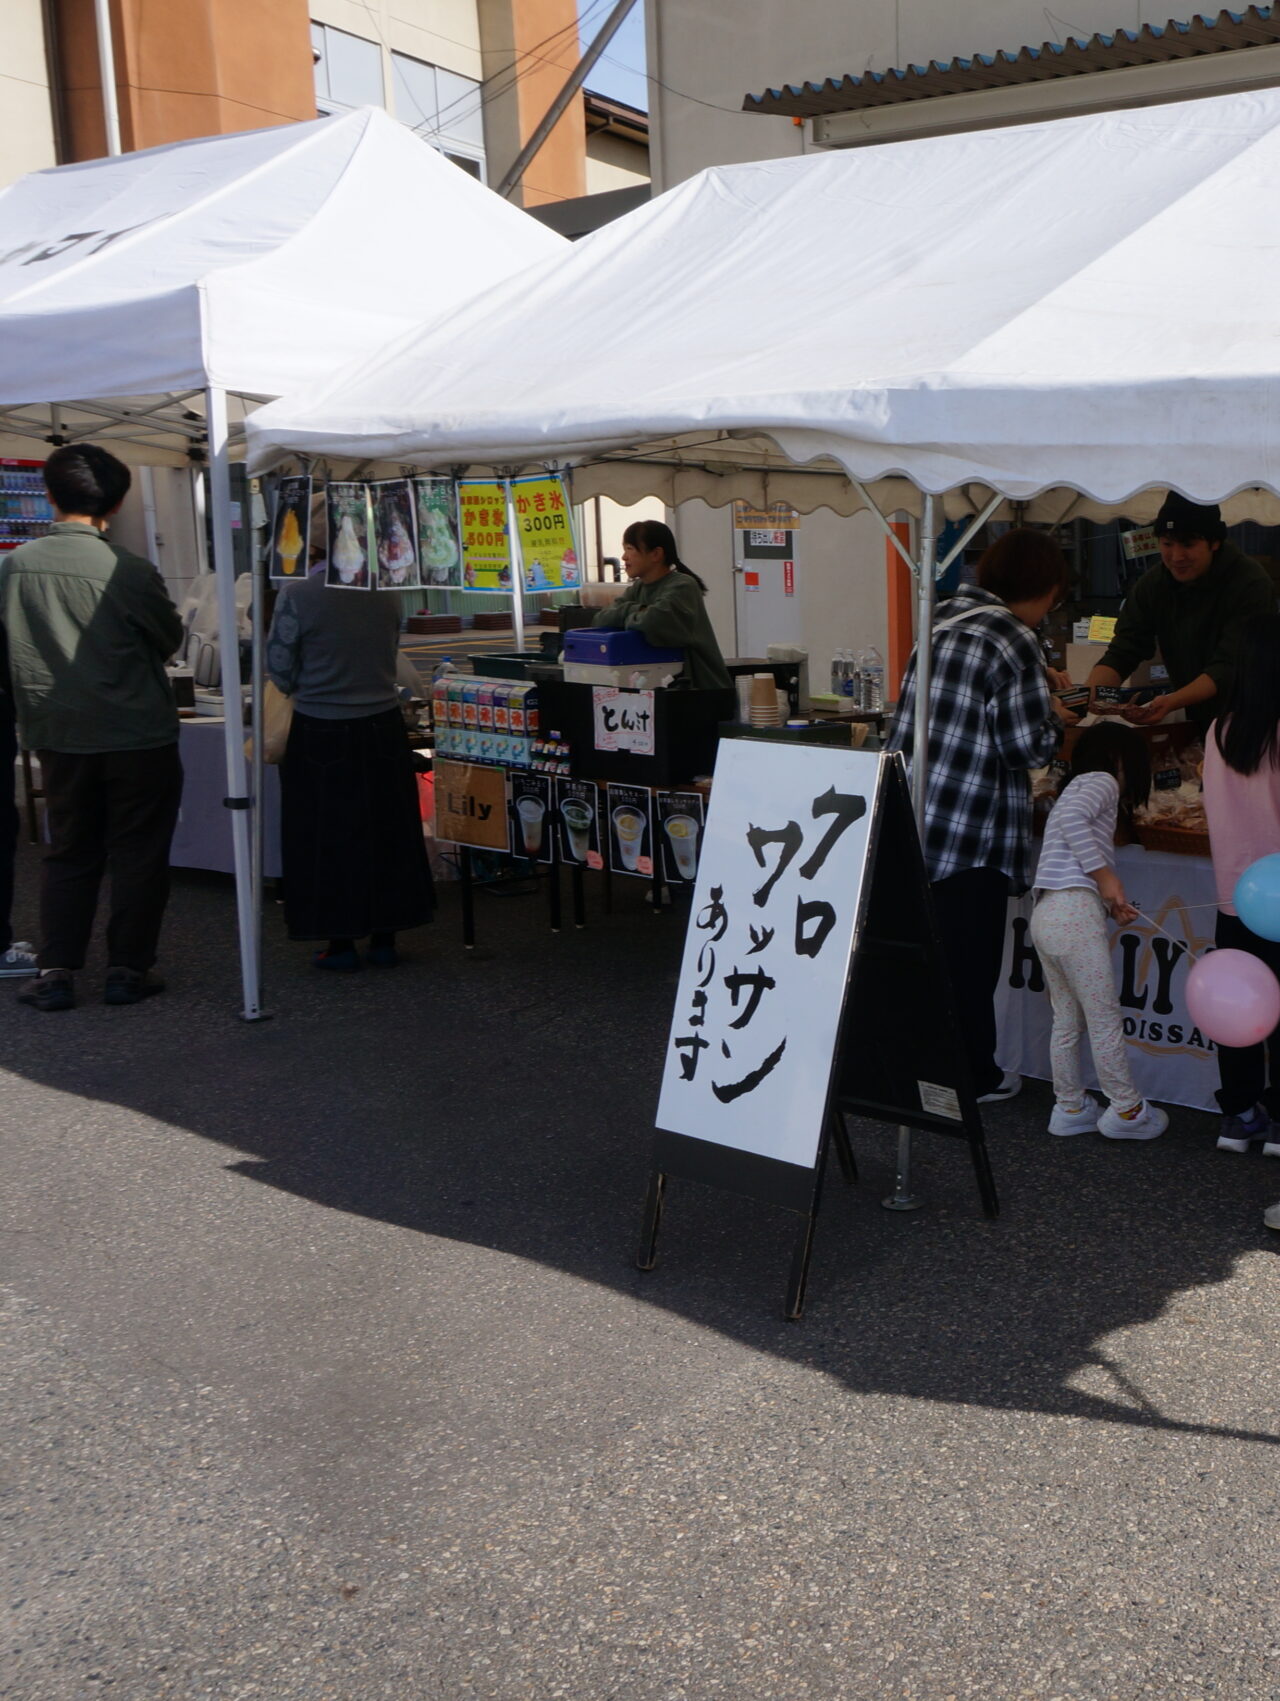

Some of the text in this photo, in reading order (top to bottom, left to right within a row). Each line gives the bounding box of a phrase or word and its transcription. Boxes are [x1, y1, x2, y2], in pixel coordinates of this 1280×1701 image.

[516, 490, 565, 513] かき氷
[464, 508, 504, 527] かき氷
[524, 514, 566, 532] 300円
[467, 532, 505, 547] 500円
[602, 705, 650, 732] とん汁
[447, 792, 492, 820] Lily
[674, 884, 729, 1082] あります
